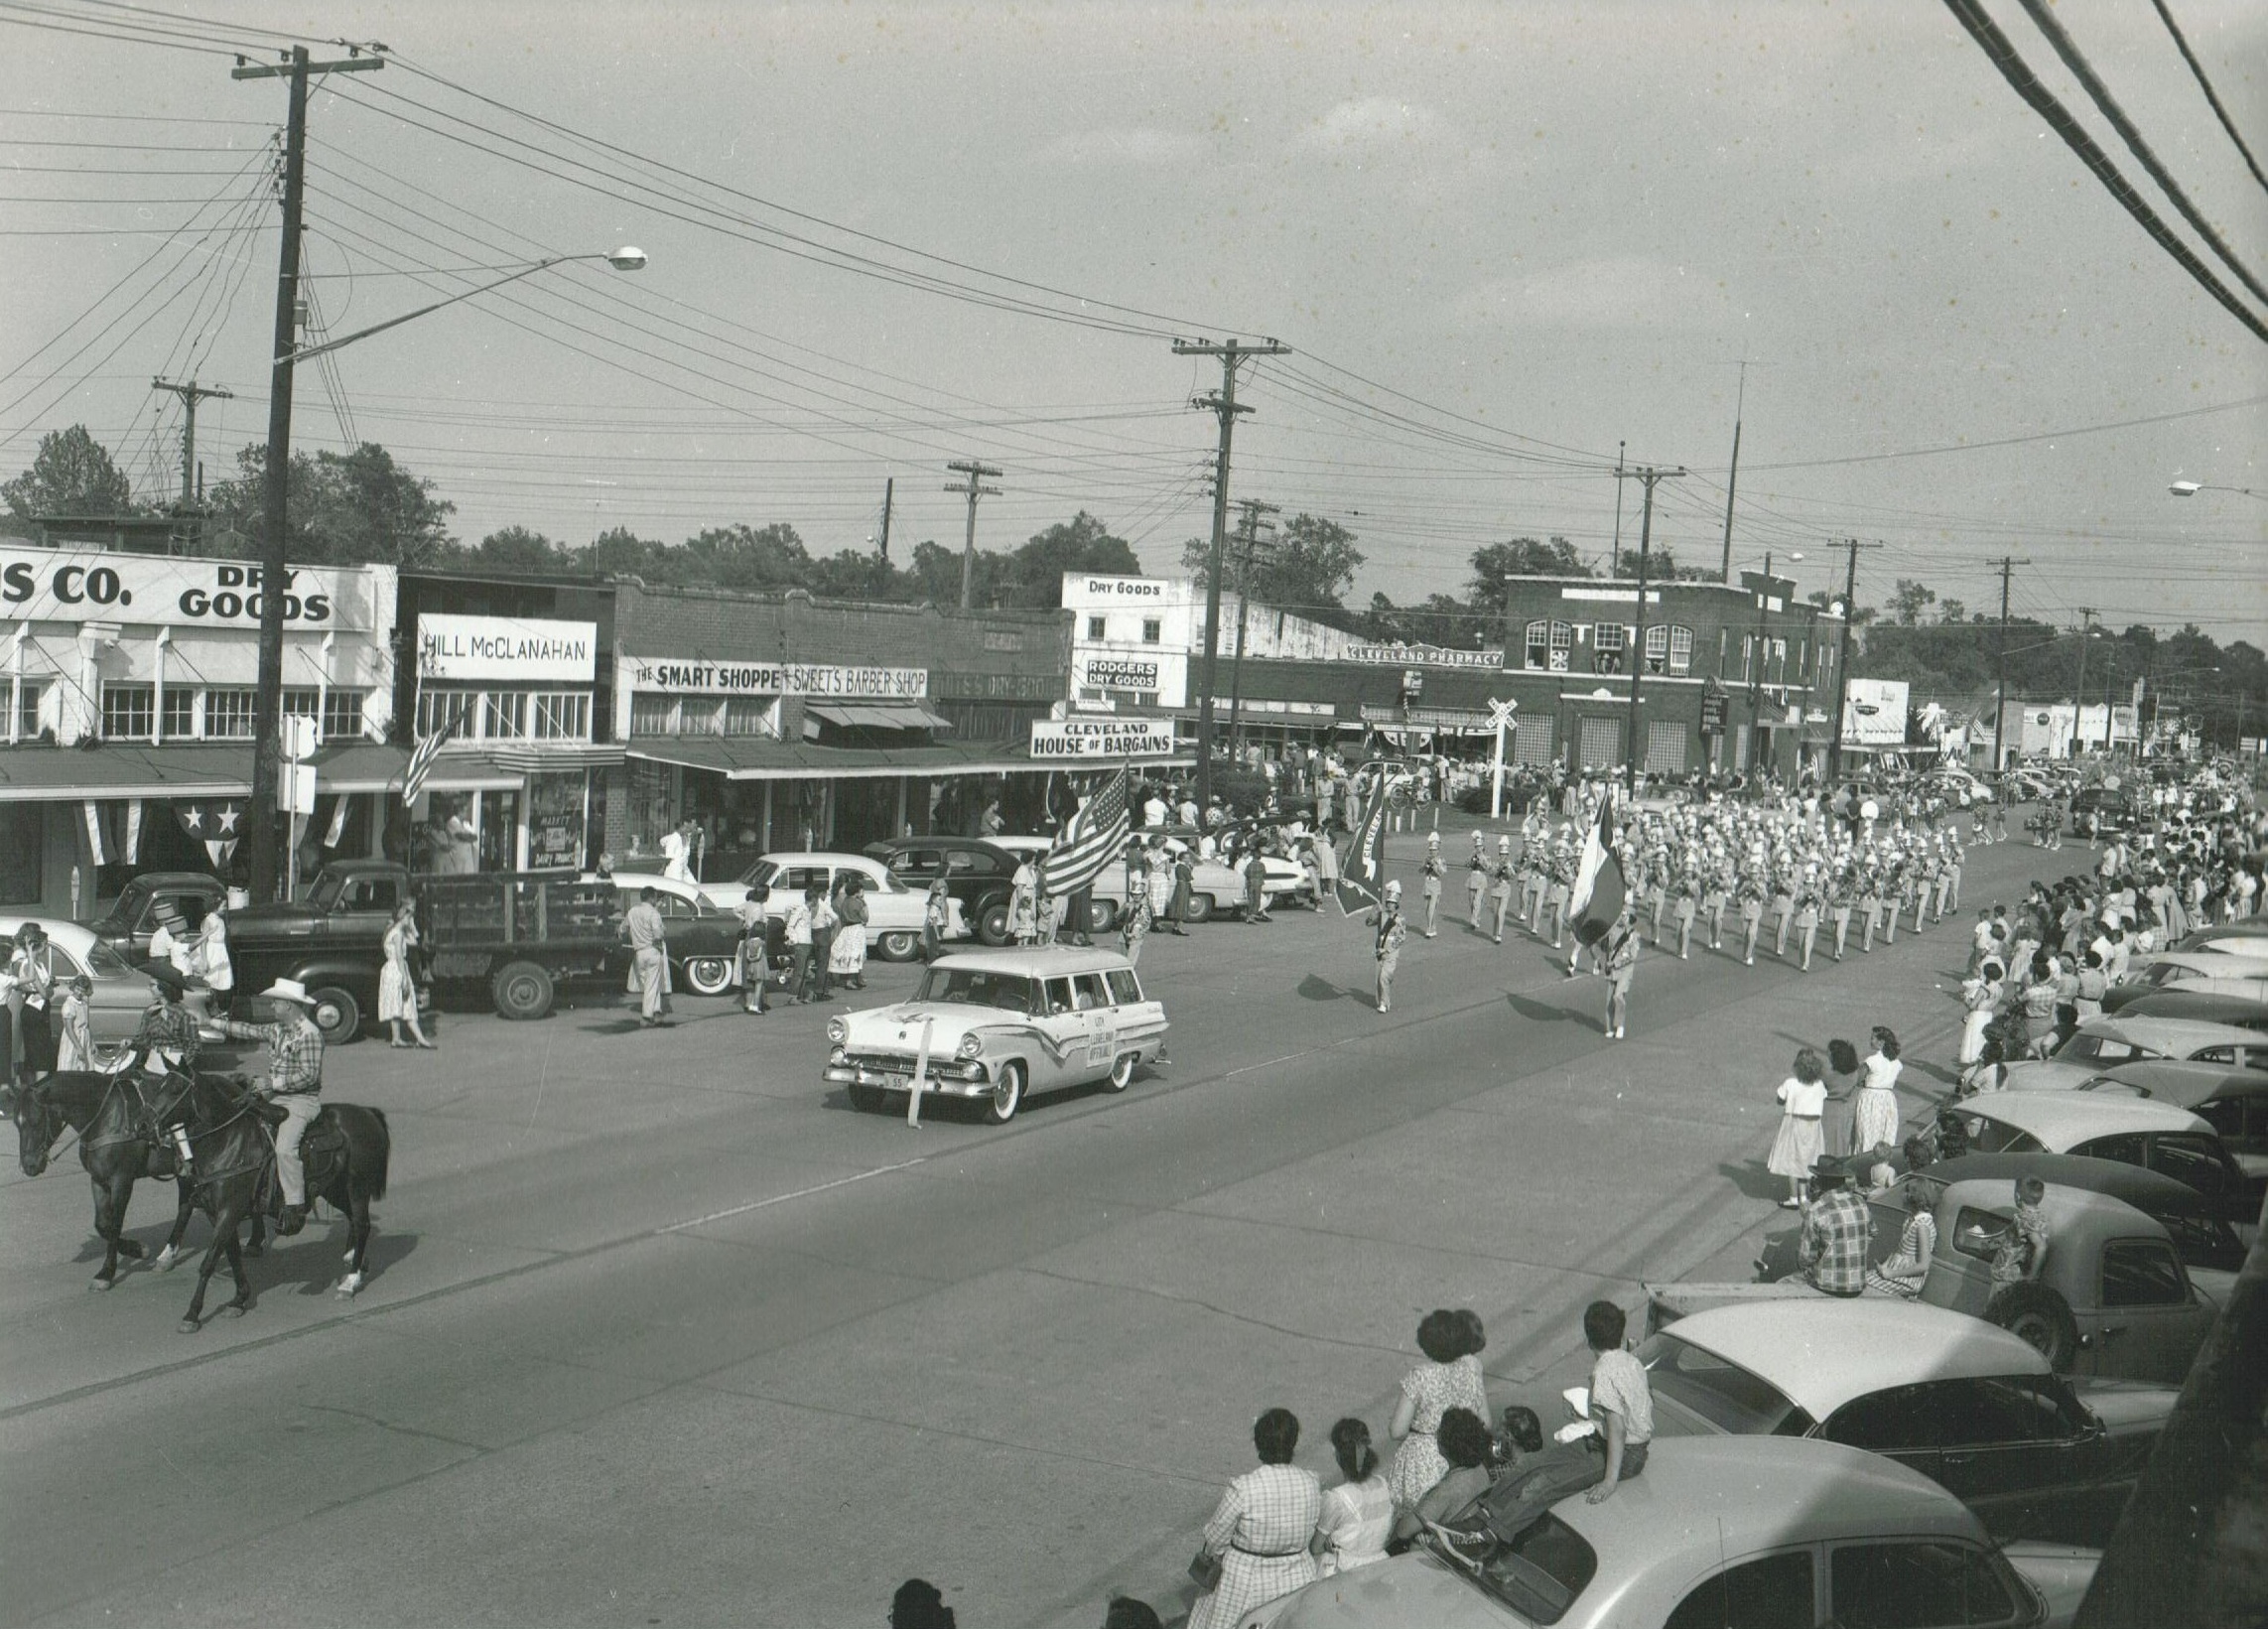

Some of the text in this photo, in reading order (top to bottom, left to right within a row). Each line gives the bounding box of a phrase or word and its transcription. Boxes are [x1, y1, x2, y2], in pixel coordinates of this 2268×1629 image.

[0, 562, 132, 607] S CO.
[217, 565, 300, 590] DRY
[179, 588, 331, 622] GOODS
[424, 634, 467, 657] HILL
[1351, 647, 1500, 666] CLEVELAND PHARMACY
[636, 665, 780, 689] THE SMART SHOPPE
[1089, 661, 1157, 675] RODGERS
[794, 666, 842, 693] SWEET'S
[846, 669, 891, 694] BARBER
[895, 671, 925, 694] SHOP
[1089, 674, 1155, 687] DRY GOODS
[1064, 724, 1148, 735] CLEVELAND
[1033, 736, 1170, 753] HOUSE OF BARGAINS
